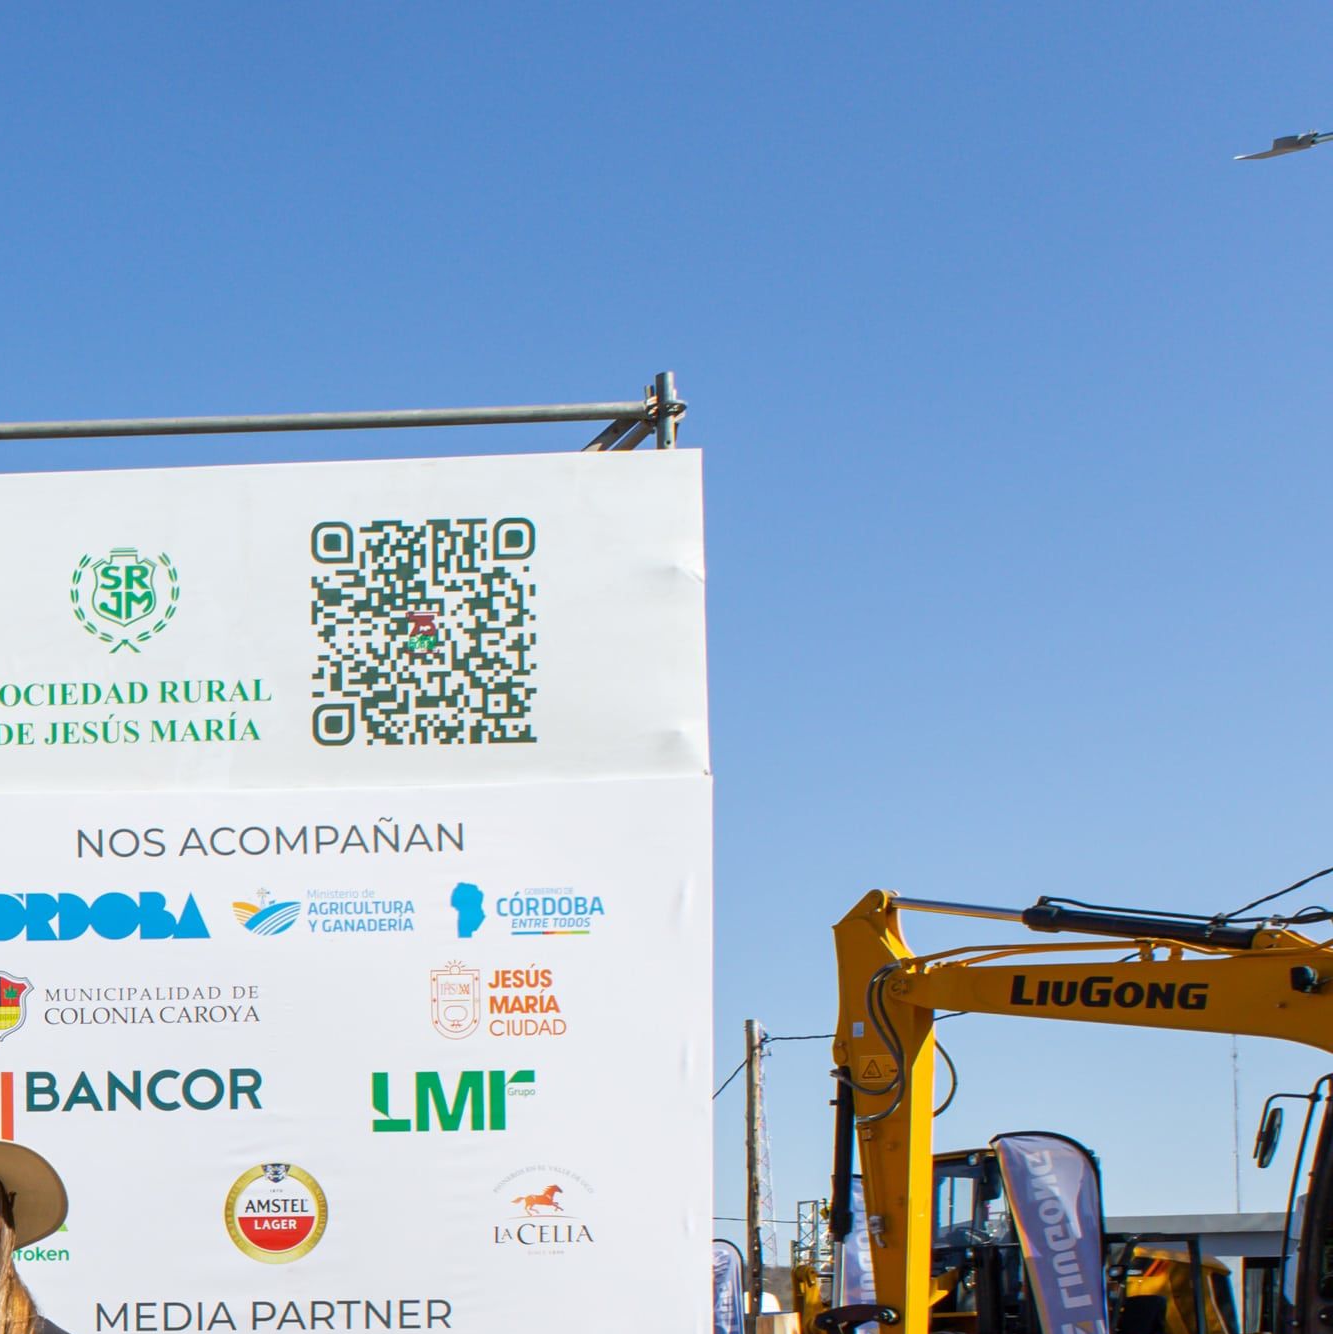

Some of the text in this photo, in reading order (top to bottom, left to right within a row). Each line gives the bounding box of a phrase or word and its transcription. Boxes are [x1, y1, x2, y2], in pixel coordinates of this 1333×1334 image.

[157, 678, 274, 705] RURAL
[44, 713, 141, 745] JESÚS
[149, 711, 262, 743] MARÍA
[75, 817, 466, 859] NOS ACOMPAÑAN
[307, 888, 375, 899] Ministerio de
[308, 900, 415, 916] AGRICULTURA
[496, 892, 605, 917] CÓRDOBA
[308, 916, 414, 932] Y GANADERÍA
[511, 917, 591, 929] ENTRE TODOS
[488, 963, 553, 988] JESÚS
[44, 985, 259, 1002] MUNICIPALIDAD DE
[489, 989, 561, 1014] MARÍA
[44, 1005, 261, 1025] COLONIA CAROYA
[489, 1019, 567, 1036] CIUDAD
[26, 1068, 263, 1112] BANCOR
[507, 1087, 536, 1098] Grupo
[245, 1199, 309, 1213] AMSTEL
[254, 1219, 297, 1230] LAGER
[13, 1247, 69, 1261] token
[95, 1299, 452, 1332] MEDIA PARTNER
